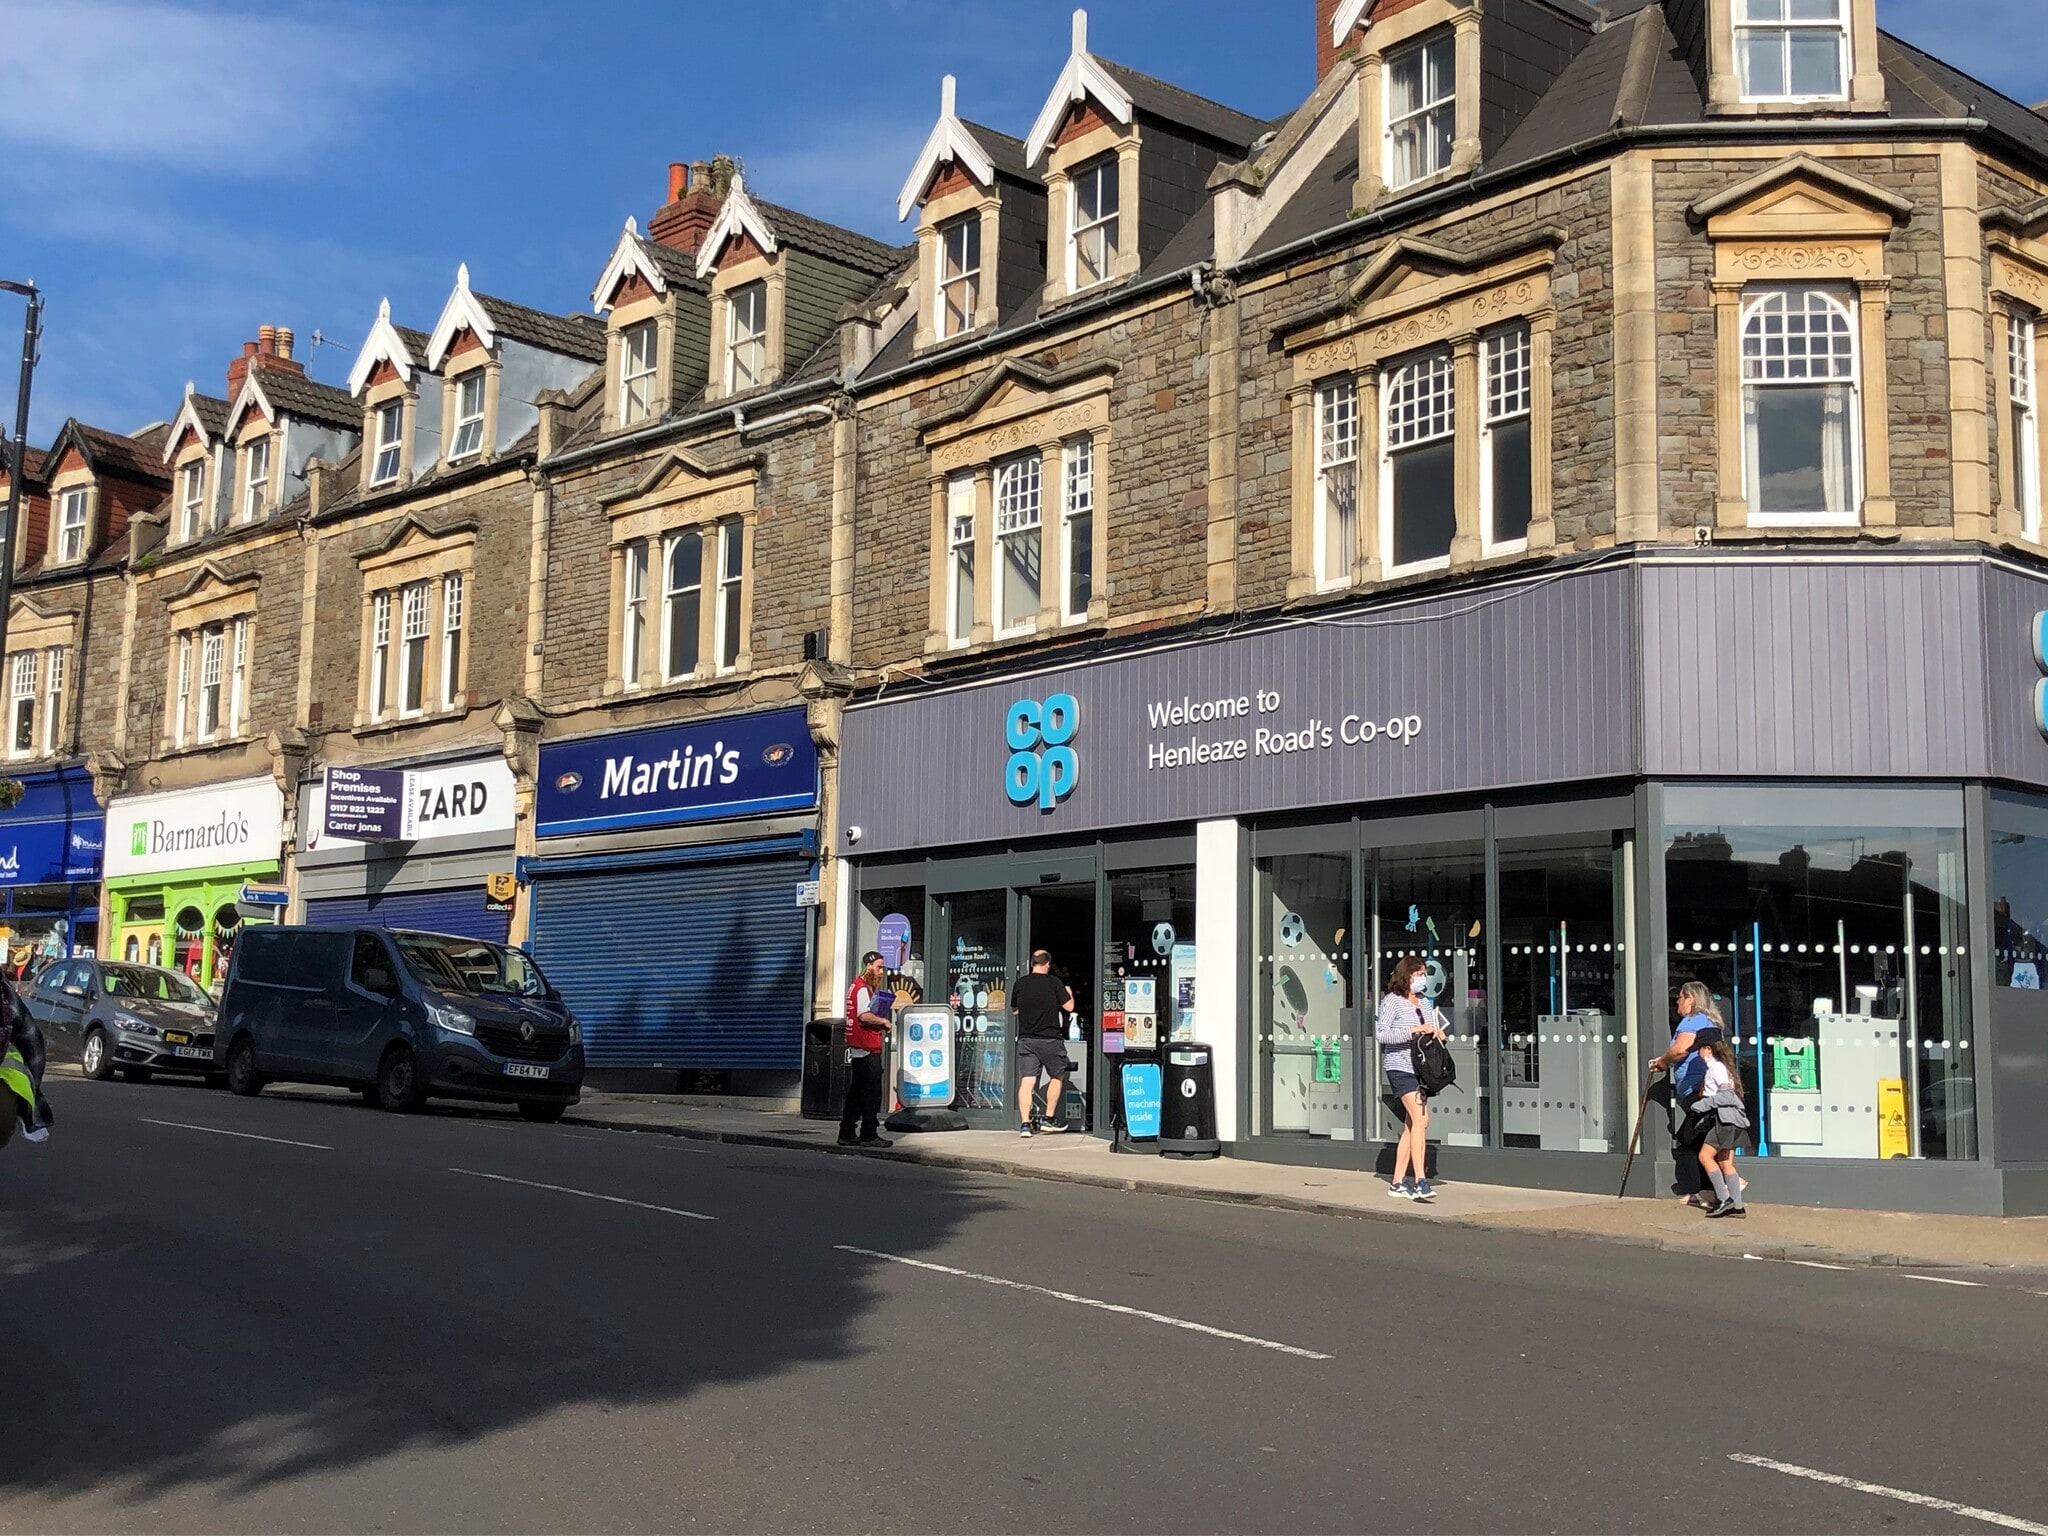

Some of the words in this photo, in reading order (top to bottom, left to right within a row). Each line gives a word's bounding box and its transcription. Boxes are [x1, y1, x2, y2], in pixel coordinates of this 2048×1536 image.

[1148, 695, 1250, 730] Welcome
[1256, 689, 1281, 713] to
[1148, 736, 1248, 770] Henleaze
[1255, 719, 1333, 757] Road's
[1340, 714, 1422, 747] Co-op
[331, 769, 361, 782] Shop
[600, 740, 741, 799] Martin's
[331, 781, 382, 794] Premises
[418, 781, 488, 822] ZARD
[329, 804, 348, 812] 0117
[366, 806, 385, 815] 1222
[406, 797, 414, 838] AVAILABLE
[151, 809, 249, 854] Barnardo's
[328, 820, 357, 831] Carter
[357, 822, 382, 833] Jonas
[508, 1064, 531, 1076] EF64
[532, 1067, 549, 1077] TVJ
[1126, 1073, 1144, 1083] Free
[1127, 1086, 1145, 1096] cash
[1128, 1099, 1161, 1108] machine
[1130, 1112, 1153, 1122] inside
